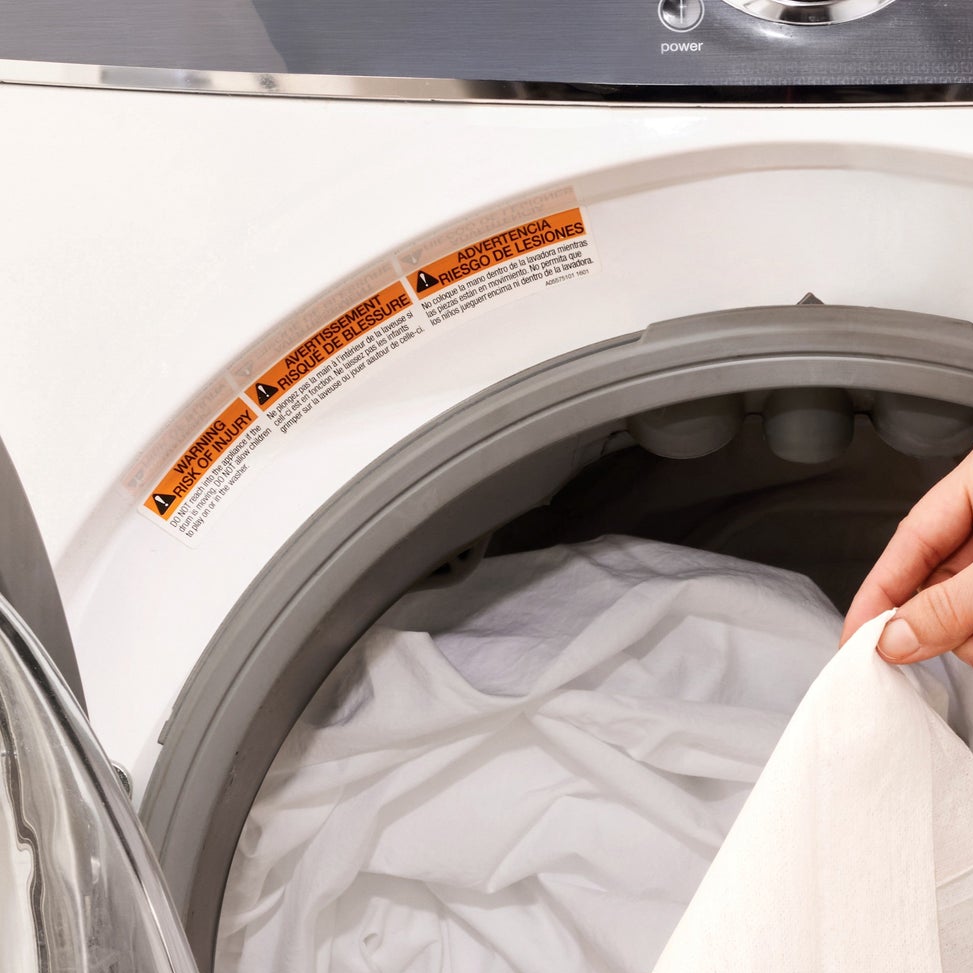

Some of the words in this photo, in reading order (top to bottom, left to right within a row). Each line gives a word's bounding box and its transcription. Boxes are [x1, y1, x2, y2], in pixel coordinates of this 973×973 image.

[661, 42, 704, 55] power
[438, 254, 491, 285] RIESGO
[492, 245, 513, 262] DE
[514, 222, 584, 253] LESIONES
[457, 219, 551, 263] ADVERTENCIA
[421, 301, 432, 310] No
[432, 288, 458, 305] coloque
[457, 284, 466, 292] la
[466, 275, 486, 288] mano
[486, 266, 508, 280] dentro
[508, 262, 519, 270] de
[526, 249, 557, 264] lavadora
[557, 240, 588, 253] mientras
[425, 308, 437, 318] las
[437, 298, 459, 314] piezas
[458, 289, 478, 302] están
[478, 284, 488, 293] en
[487, 268, 529, 288] movimiento.
[529, 264, 540, 272] No
[540, 255, 568, 270] permita
[568, 251, 582, 261] que
[285, 294, 381, 369] AVERTISSEMENT
[322, 336, 343, 355] DE
[341, 293, 410, 342] BLESSURE
[169, 516, 181, 528] DO
[177, 502, 191, 517] NOT
[189, 486, 205, 504] reach
[201, 474, 215, 487] into
[211, 465, 223, 476] the
[221, 439, 248, 466] appliance
[246, 433, 252, 441] if
[249, 425, 261, 436] the
[172, 467, 201, 498] RISK
[197, 449, 213, 469] OF
[211, 411, 252, 453] INJURY
[173, 420, 226, 474] WARNING
[179, 515, 194, 533] drum
[213, 476, 225, 487] DO
[222, 464, 236, 478] NOT
[234, 448, 250, 465] allow
[249, 428, 272, 450] children
[185, 530, 194, 538] to
[191, 517, 204, 532] play
[201, 508, 211, 518] on
[208, 501, 216, 510] or
[214, 494, 222, 503] in
[218, 485, 230, 496] the
